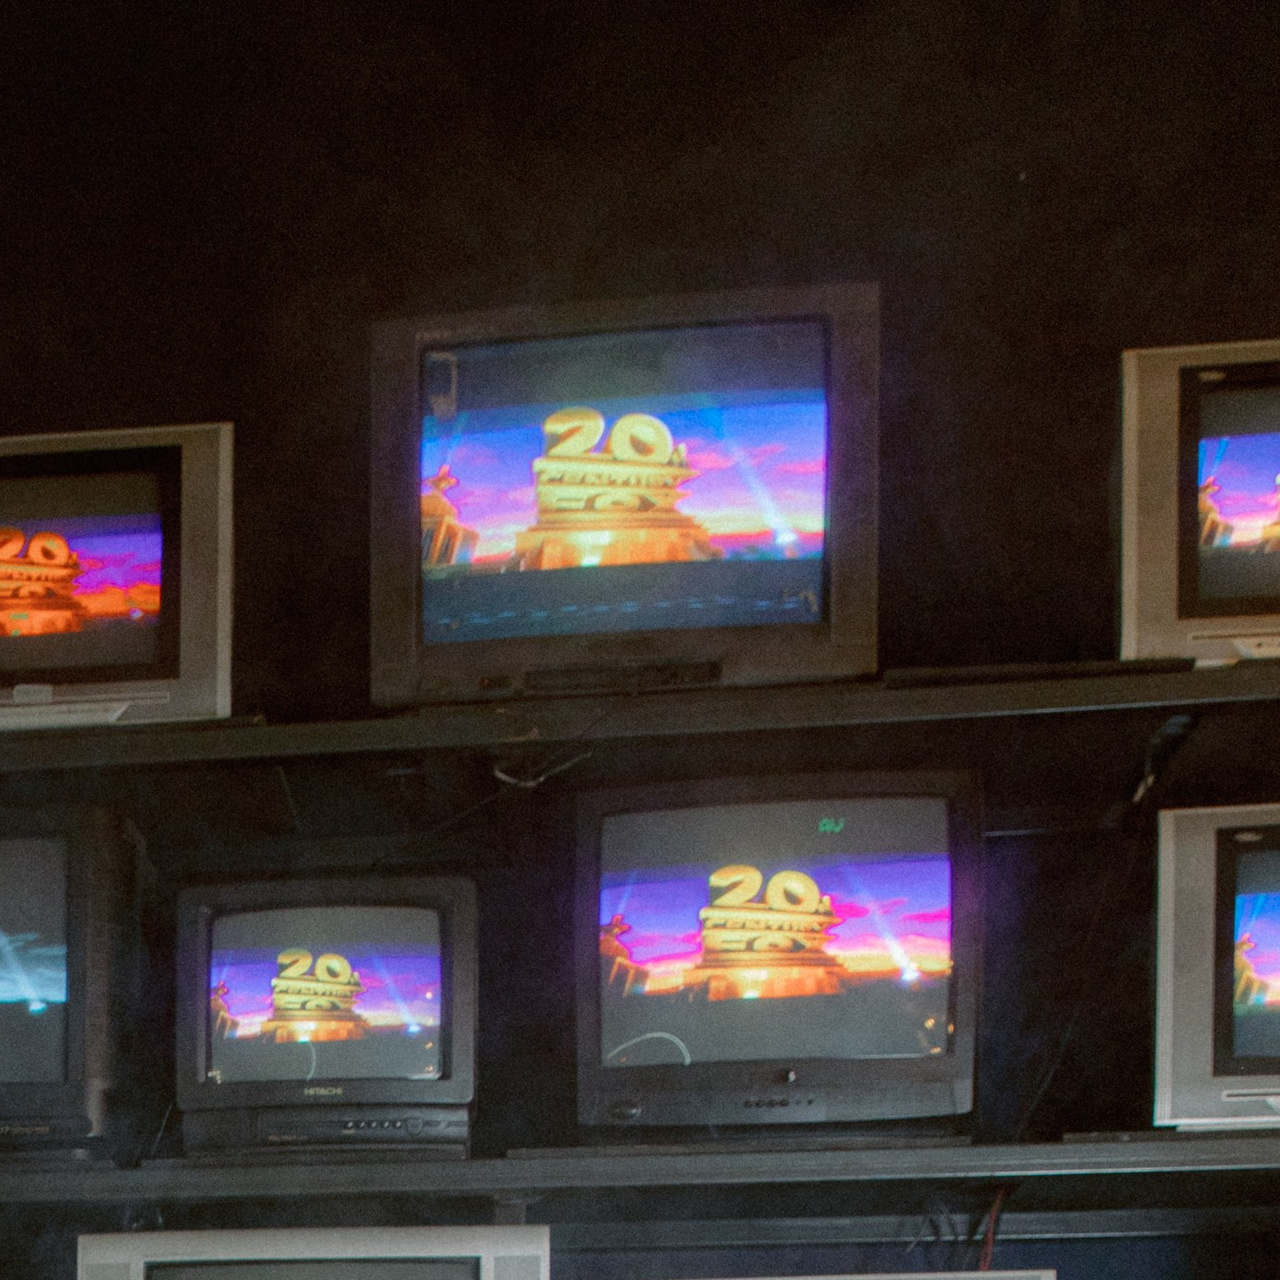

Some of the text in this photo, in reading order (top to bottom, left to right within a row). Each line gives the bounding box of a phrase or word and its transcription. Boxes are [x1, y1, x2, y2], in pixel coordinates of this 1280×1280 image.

[544, 407, 674, 464] 20
[708, 864, 820, 914] 20
[277, 948, 351, 985] 20
